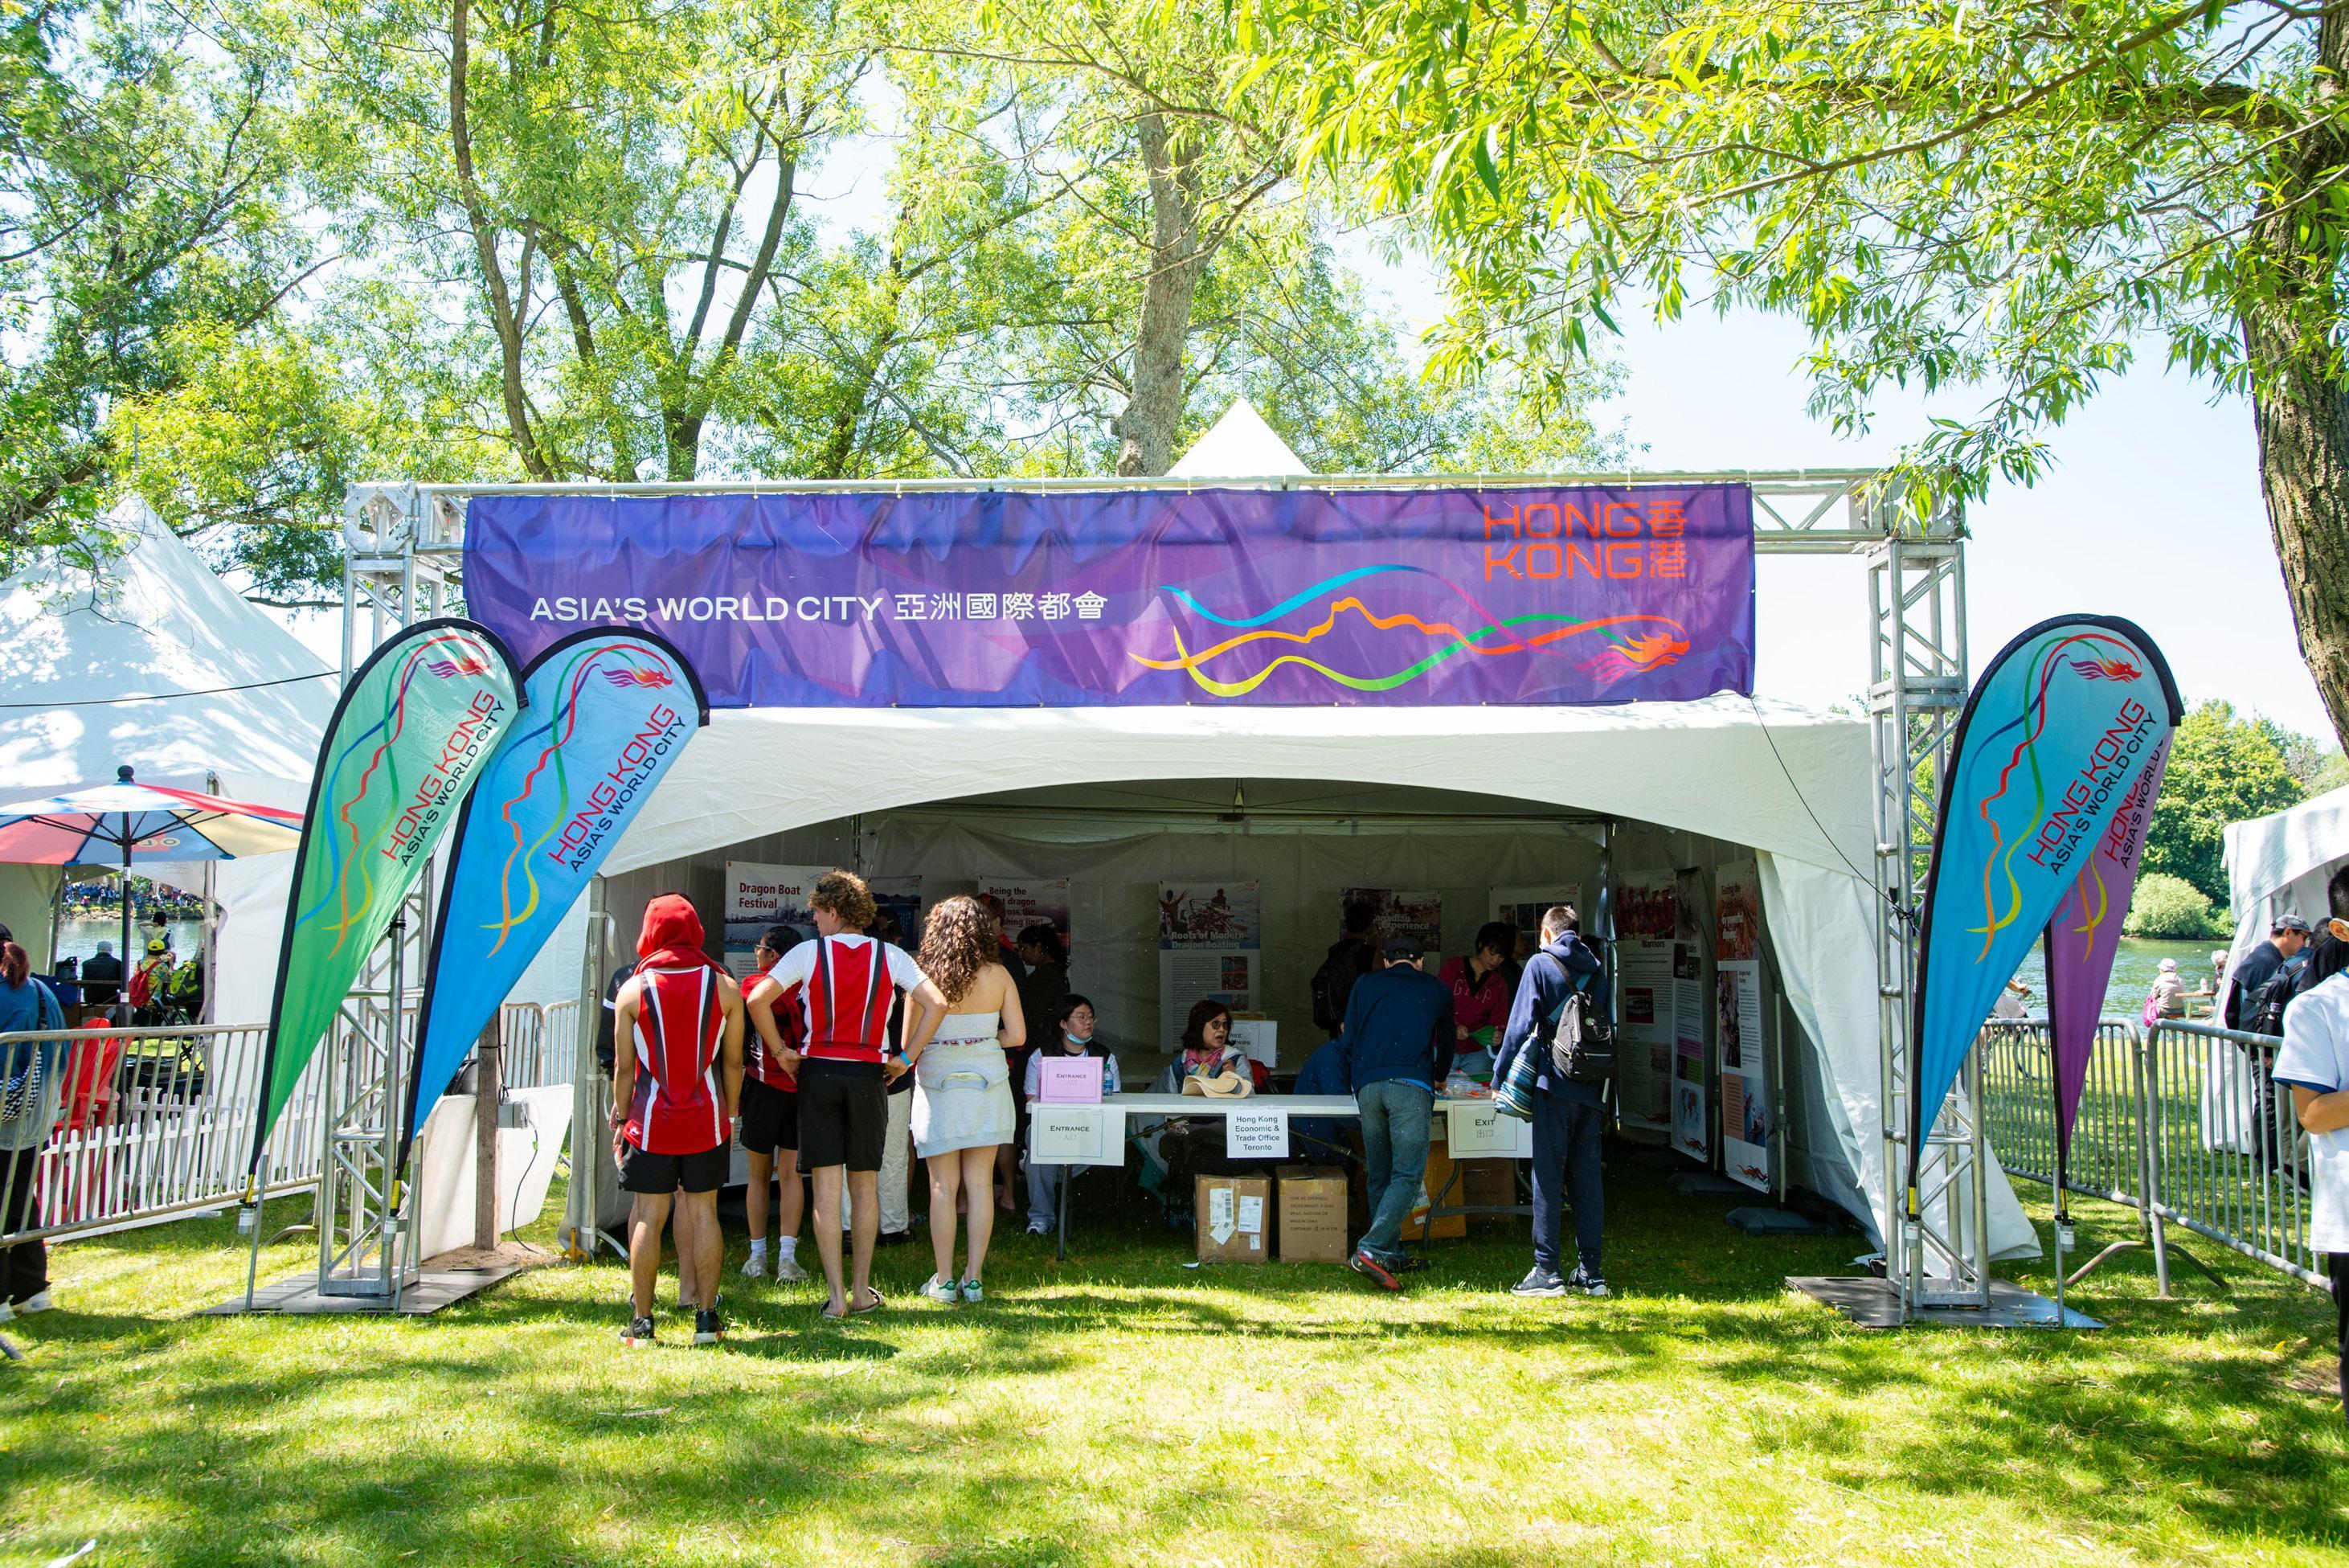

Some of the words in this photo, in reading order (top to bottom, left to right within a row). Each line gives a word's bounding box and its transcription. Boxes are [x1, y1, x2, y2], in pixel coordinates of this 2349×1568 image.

[1483, 502, 1641, 539] HONG
[1484, 542, 1642, 582] KONG
[530, 597, 647, 621] ASIA'S
[657, 597, 788, 621] WORLD
[796, 596, 883, 621] CITY
[894, 590, 1108, 620] 亞洲國際都會
[381, 773, 442, 862] HONG
[433, 688, 495, 775] KONG
[401, 808, 440, 867] ASIA'S
[435, 740, 479, 809] WORLD
[476, 700, 505, 743] CITY
[546, 780, 617, 866] HONG
[607, 702, 676, 786] KONG
[2027, 779, 2092, 867] HONG
[2086, 696, 2146, 788] KONG
[569, 817, 612, 874] ASIA'S
[608, 754, 657, 818] WORLD
[653, 715, 687, 757] CITY
[2049, 817, 2090, 876] ASIA'S
[2084, 753, 2130, 818] WORLD
[2126, 710, 2158, 755] CITY
[2120, 812, 2142, 869] ASIA'S
[2136, 749, 2161, 809] WORLD
[739, 882, 775, 897] Dragon
[778, 883, 800, 895] Boat
[989, 886, 1012, 897] Being
[1013, 886, 1027, 895] the
[1008, 897, 1036, 907] dragon
[739, 898, 778, 909] Festival
[1374, 914, 1411, 922] anadian
[1171, 931, 1196, 940] Roots
[1197, 931, 1208, 940] of
[1210, 931, 1244, 940] Modern
[1171, 940, 1203, 951] Dragon
[1205, 940, 1240, 951] Boating
[1236, 1116, 1256, 1124] Hong
[1258, 1116, 1278, 1124] Kong
[1476, 1128, 1494, 1139] 出口
